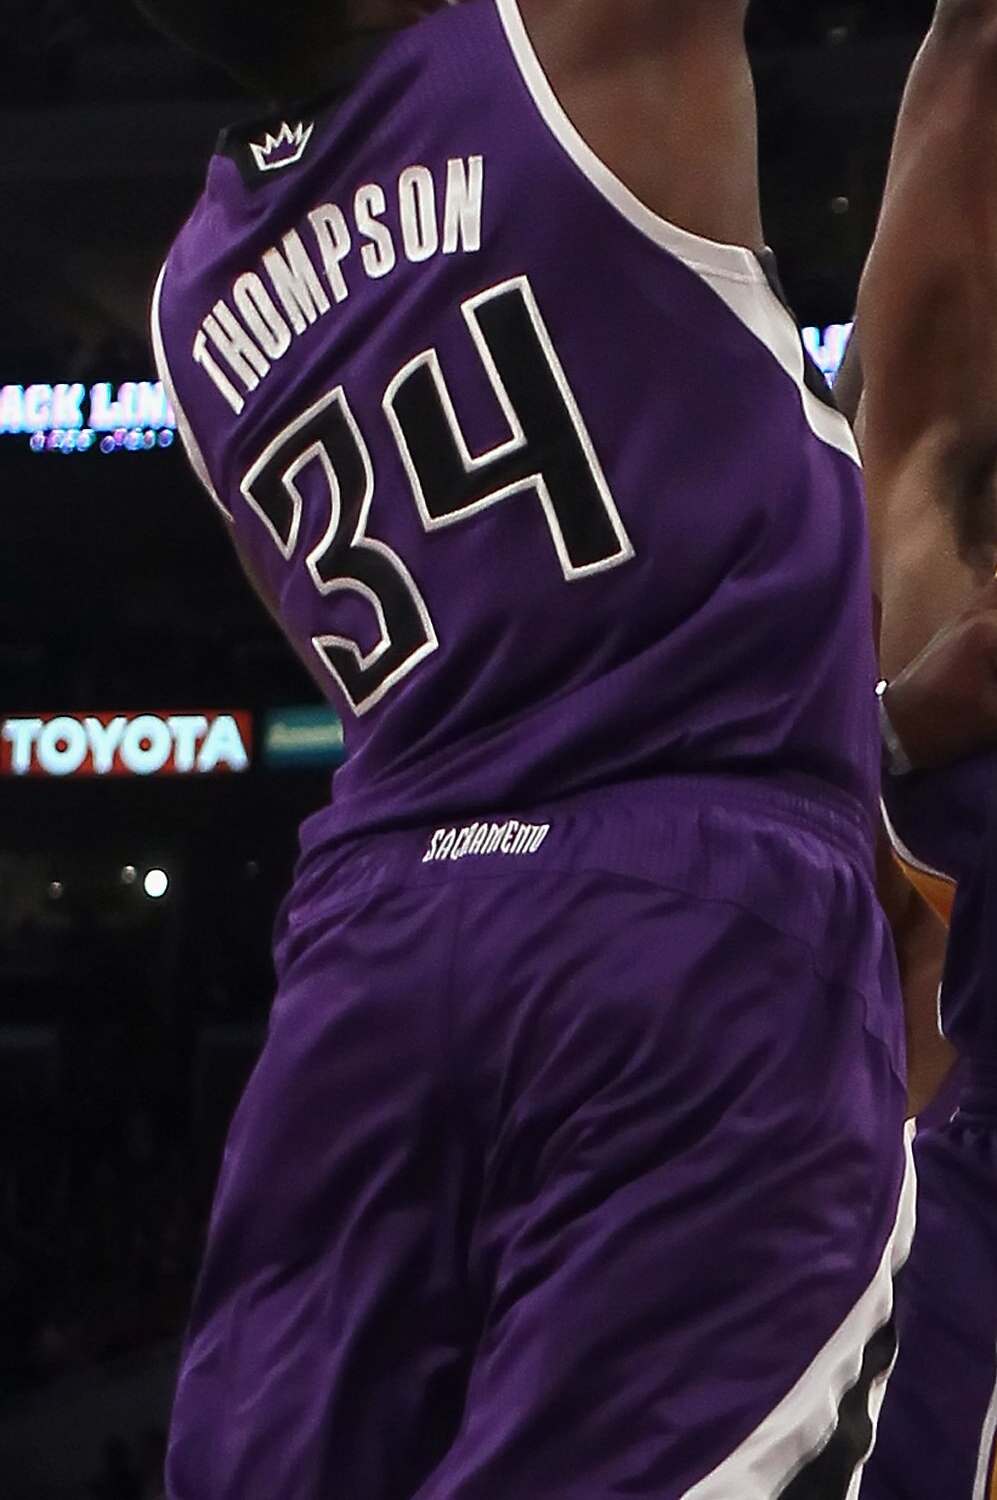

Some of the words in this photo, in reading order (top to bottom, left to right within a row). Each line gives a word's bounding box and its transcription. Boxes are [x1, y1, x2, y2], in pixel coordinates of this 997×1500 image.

[191, 155, 486, 415] THOMPSON
[88, 381, 177, 432] LIN
[240, 274, 636, 718] 34
[2, 713, 249, 776] TOYOTA
